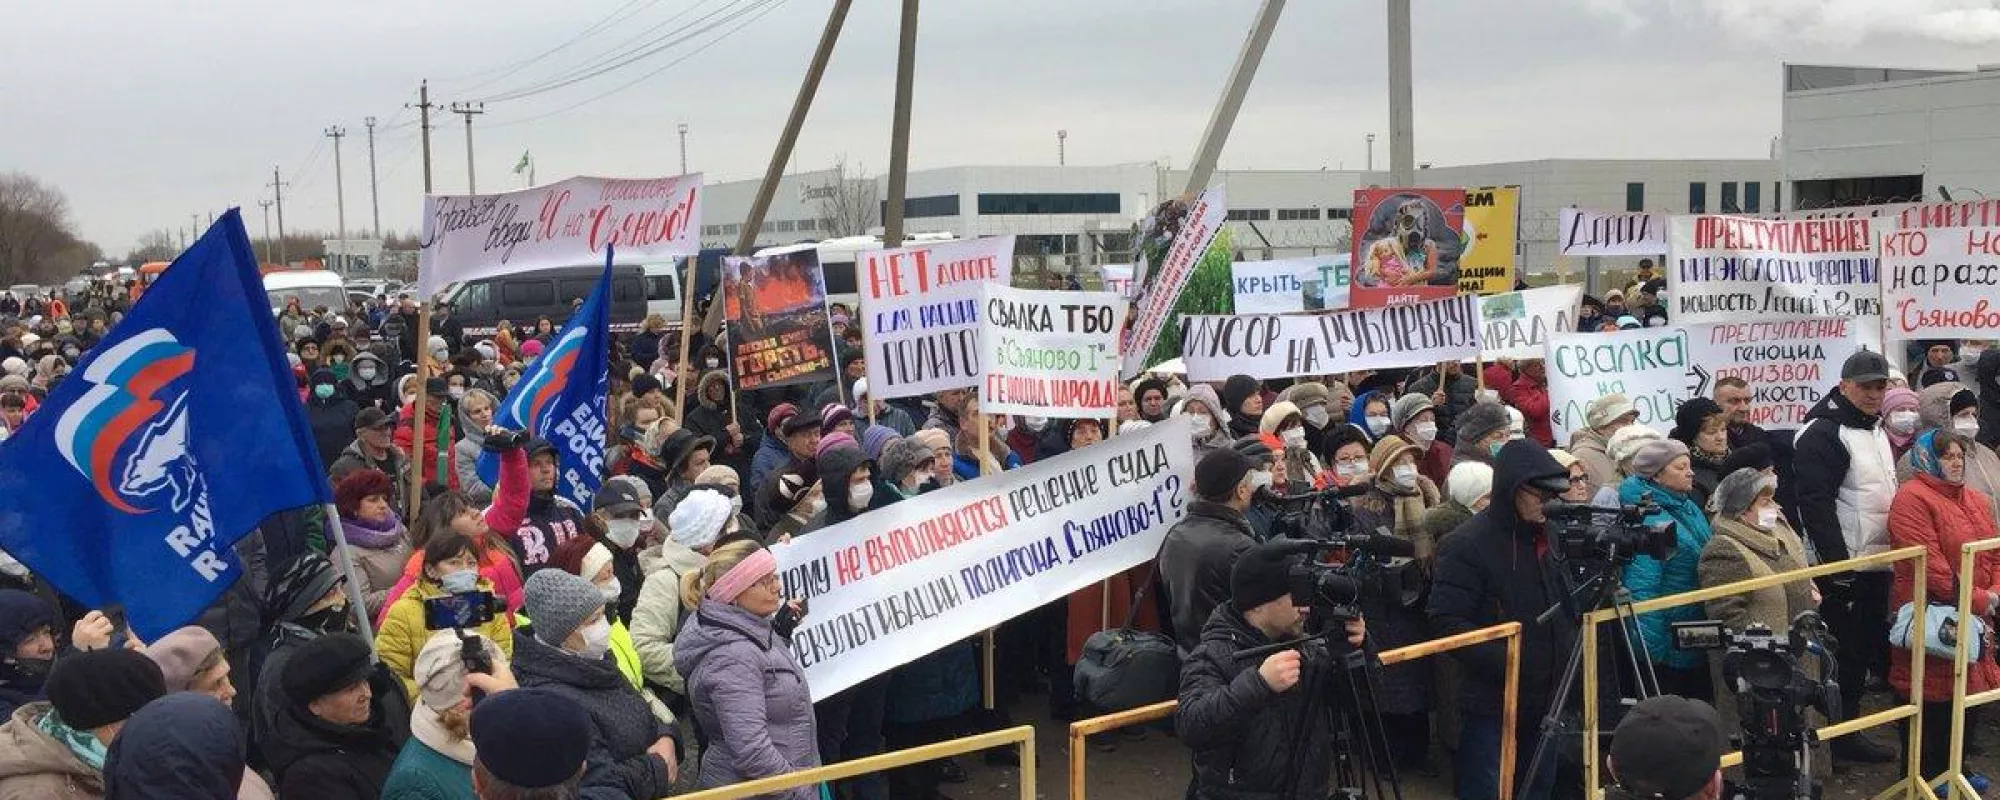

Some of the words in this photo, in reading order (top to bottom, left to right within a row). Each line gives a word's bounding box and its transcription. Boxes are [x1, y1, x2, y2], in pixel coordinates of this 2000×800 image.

[1695, 215, 1870, 254] ПРЕСТУПЛЕНИЕ!
[1884, 231, 1928, 256] КТО
[869, 249, 932, 299] НЕТ
[936, 255, 999, 288] ДОРОГЕ
[875, 308, 913, 335] ДЛЯ
[987, 297, 1053, 333] СВАЛКА
[1060, 304, 1114, 334] ТБО
[1710, 318, 1848, 346] ПРЕСТУПЛЕНИЕ
[1180, 316, 1281, 358] МУСОР
[1286, 337, 1320, 373] НА
[987, 373, 1050, 408] ГЕНОЦИД
[864, 493, 1010, 577] ВЫПОЛНЯЕТСЯ
[1009, 464, 1101, 522] РЕШЕНИЕ
[1107, 442, 1171, 488] СУДА
[960, 536, 1063, 601] ПОЛИГОНА
